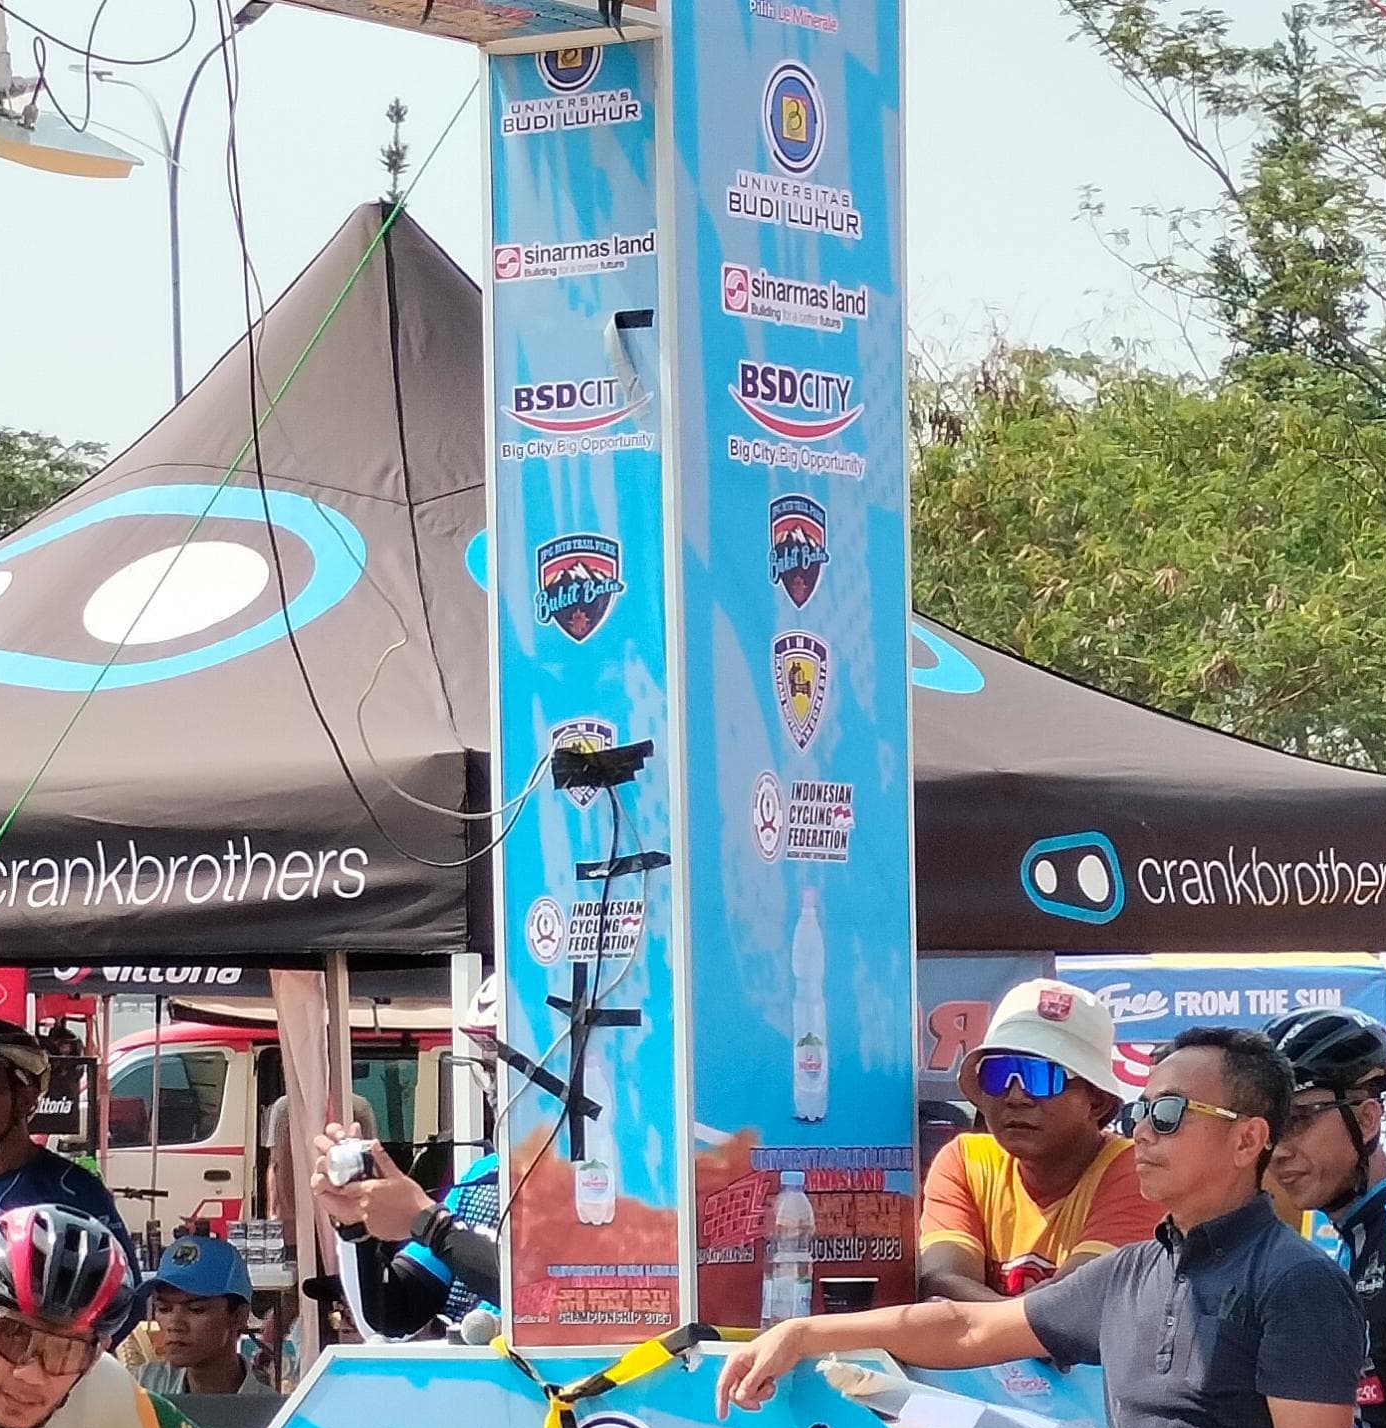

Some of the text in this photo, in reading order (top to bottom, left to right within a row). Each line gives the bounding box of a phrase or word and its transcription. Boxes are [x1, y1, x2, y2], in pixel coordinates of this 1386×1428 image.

[510, 91, 630, 114] UNIVERSITAS
[502, 103, 639, 134] BUDI LUHUR
[738, 174, 850, 208] UNIVERSITAS
[728, 191, 859, 235] BUDI LUHUR
[524, 232, 655, 265] sinarmas land
[524, 267, 557, 277] Building
[600, 260, 625, 270] future
[751, 272, 866, 316] sinarmas land
[751, 303, 782, 321] Building
[514, 379, 619, 413] BSDCIT
[740, 363, 852, 412] BSDCITY
[502, 444, 524, 460] Big
[557, 439, 577, 456] Big
[580, 434, 654, 454] Opportunity
[730, 438, 751, 460] Big
[780, 448, 798, 467] Big
[800, 452, 865, 475] Opportunity
[535, 581, 580, 622] Bukit
[791, 782, 853, 804] INDONESIAN
[789, 804, 833, 826] CYCLING
[787, 827, 848, 849] FEDERATION
[569, 918, 620, 935] CYCLNG
[1095, 983, 1343, 1023] Free FROM THE SUN
[36, 1095, 73, 1115] ittoria
